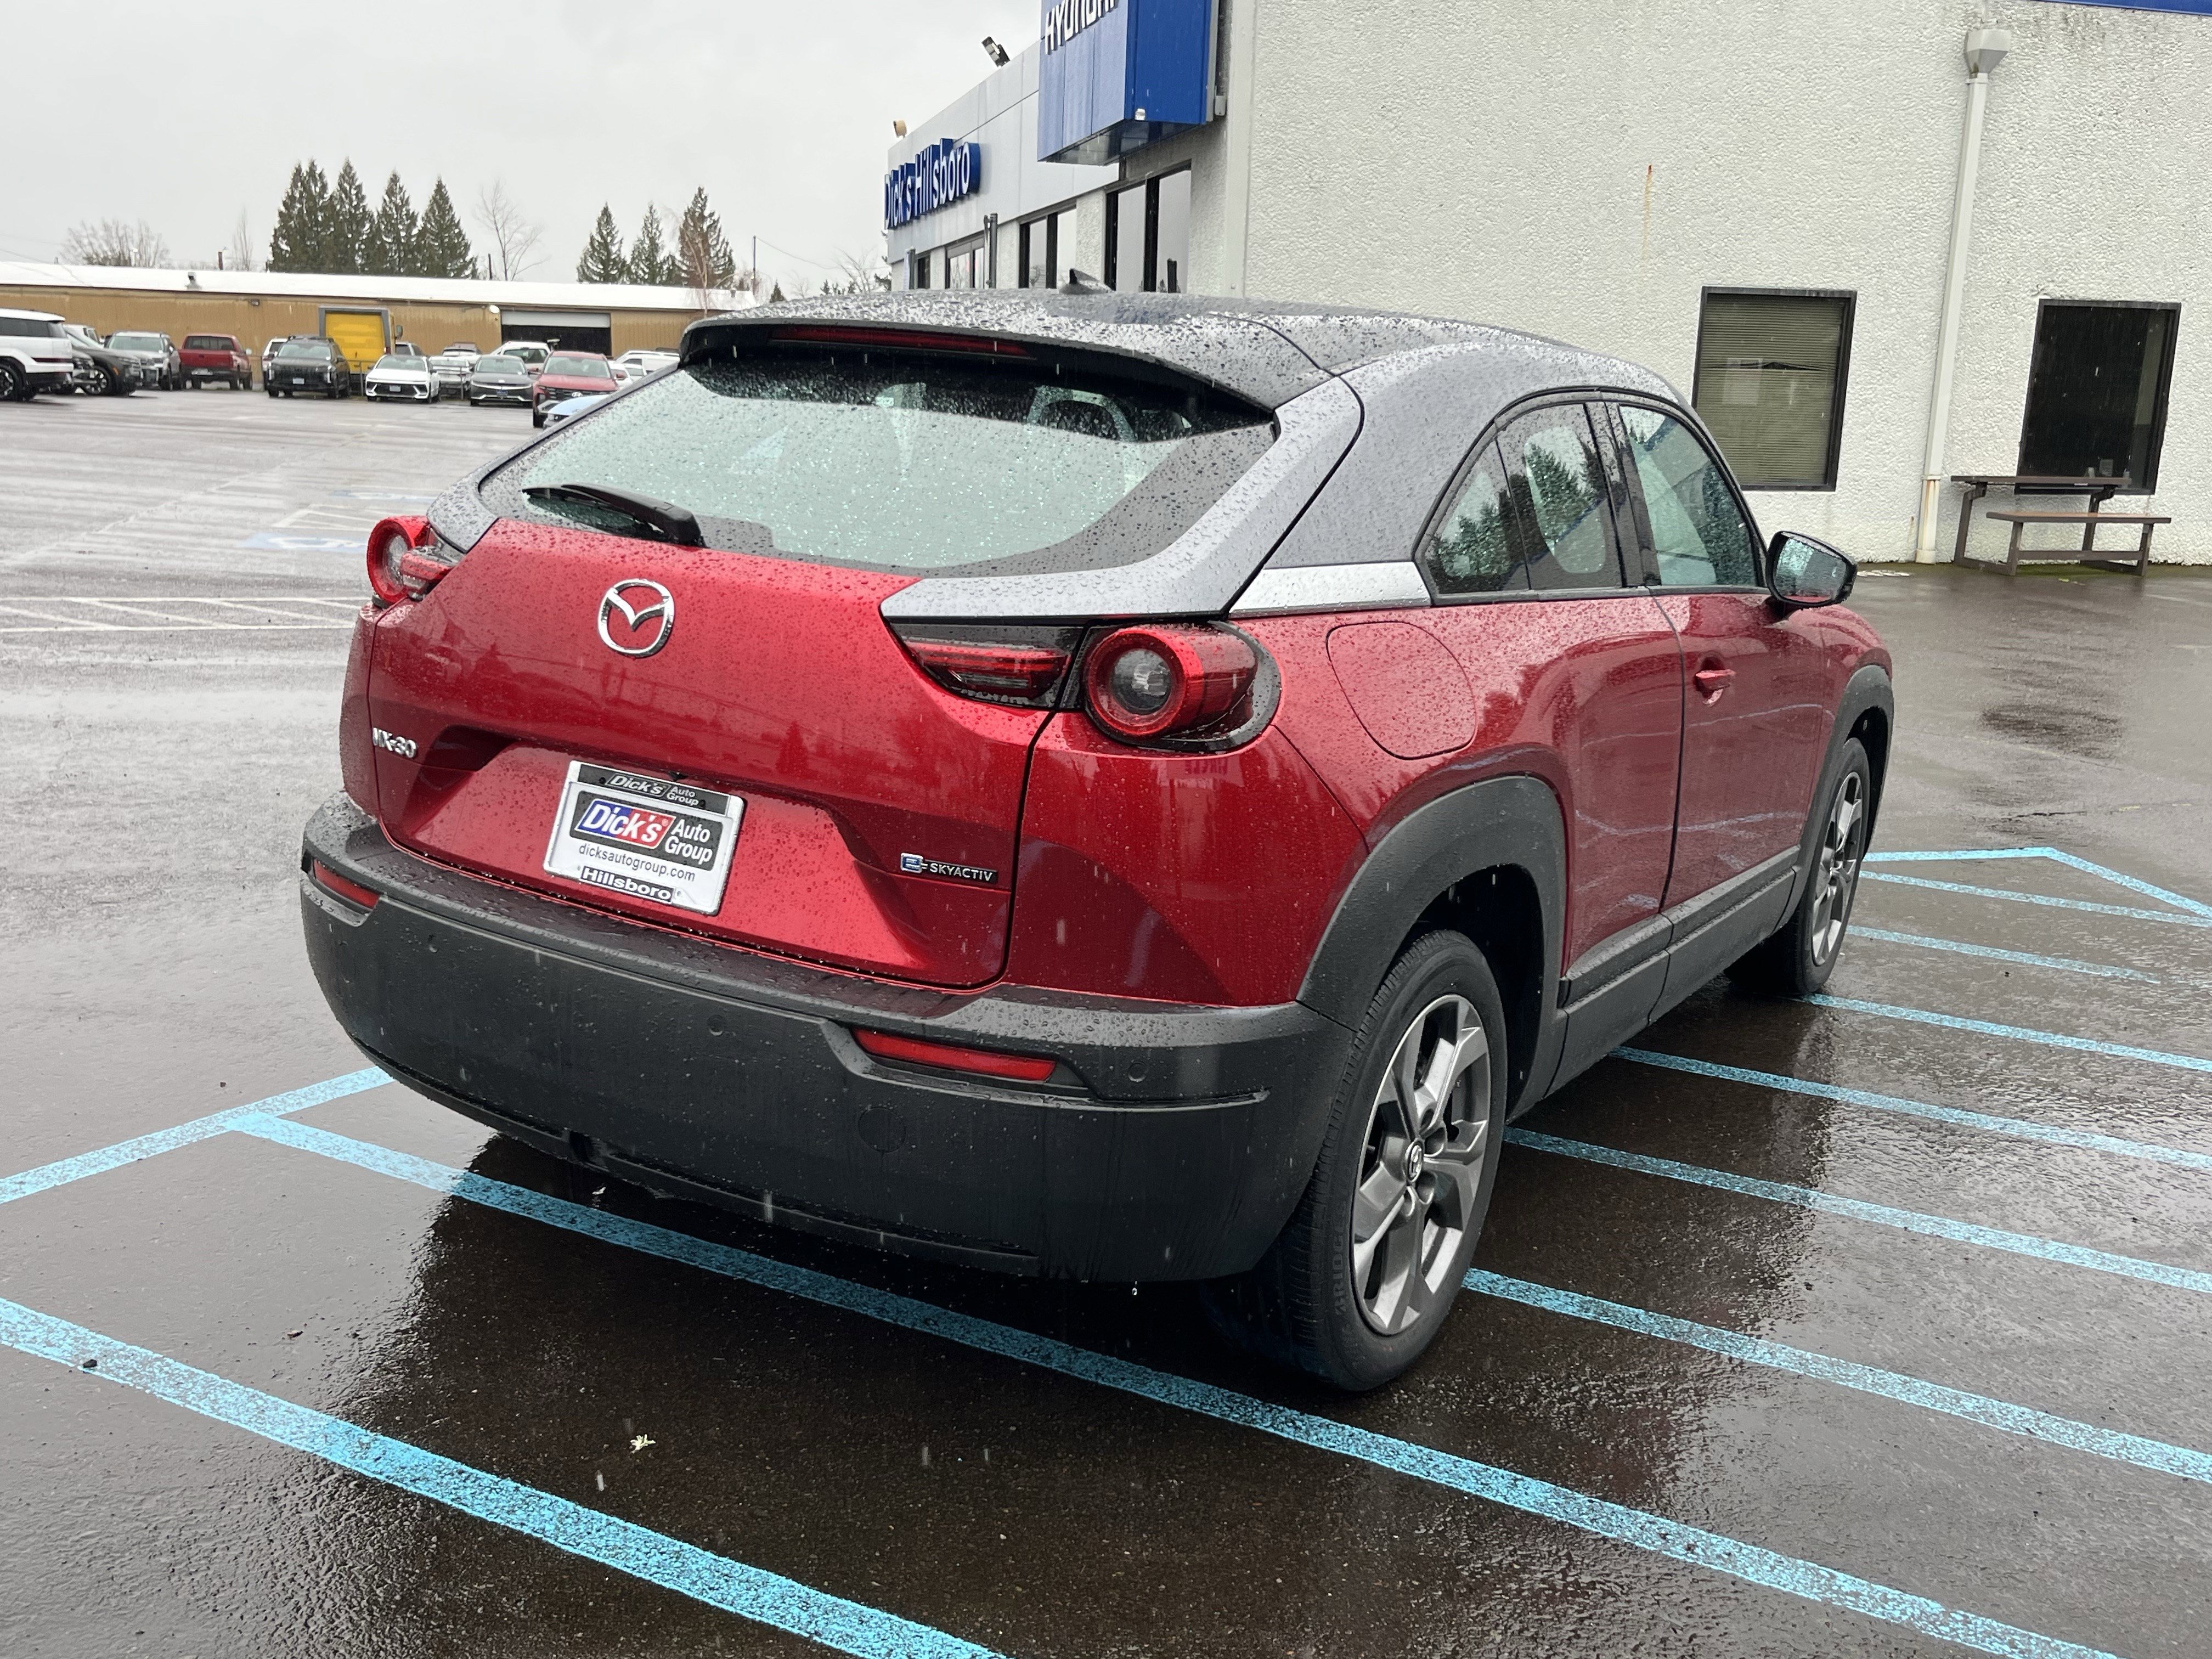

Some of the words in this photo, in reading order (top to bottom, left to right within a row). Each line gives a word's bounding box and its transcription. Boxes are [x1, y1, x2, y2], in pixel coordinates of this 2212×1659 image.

[1045, 0, 1114, 54] HYUND
[884, 163, 912, 229] Dick's
[915, 138, 971, 216] Hillsboro
[610, 775, 663, 794] Dick's
[670, 786, 696, 798] Auto
[667, 792, 699, 806] Group
[582, 804, 662, 844] Dick's
[671, 819, 711, 843] Auto
[579, 843, 696, 882] dicksautogroup.com
[664, 836, 713, 866] Group
[583, 866, 672, 901] Hillsboro
